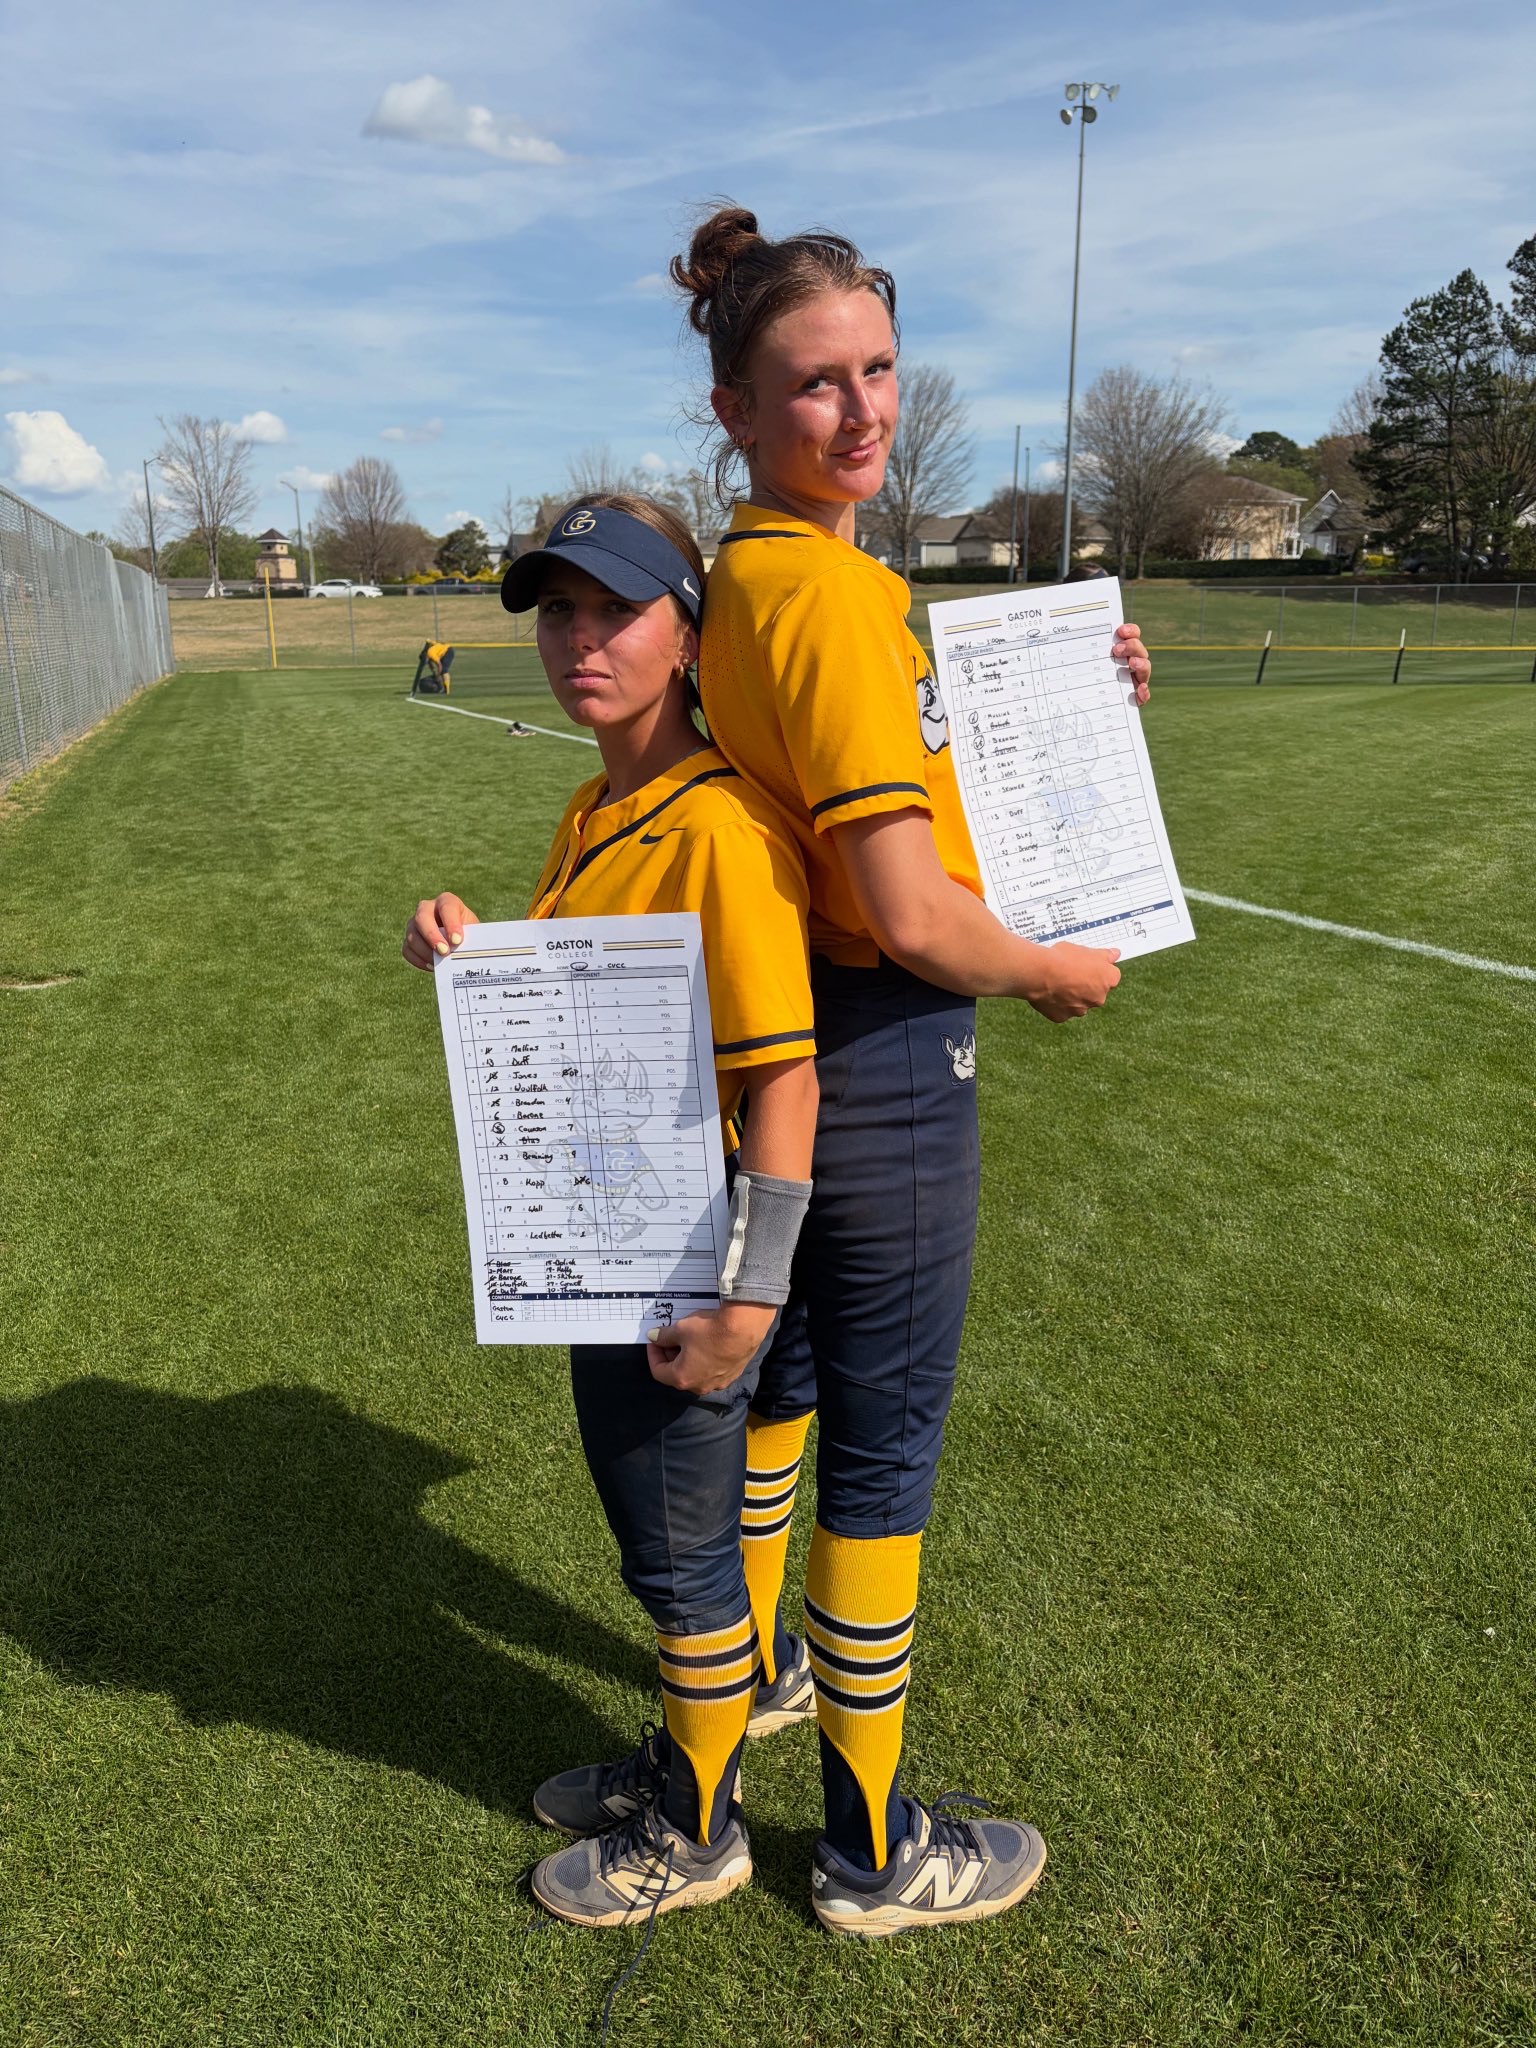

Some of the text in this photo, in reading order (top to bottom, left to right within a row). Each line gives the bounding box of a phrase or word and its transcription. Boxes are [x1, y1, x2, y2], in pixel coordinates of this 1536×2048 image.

[562, 510, 596, 536] G
[1007, 609, 1042, 622] GASTON
[1009, 619, 1043, 629] COLLEGE
[963, 649, 980, 657] COLLEGE
[546, 939, 593, 951] GASTON
[547, 950, 594, 960] COLLEGE
[465, 968, 484, 979] April
[554, 988, 563, 996] 2
[559, 1042, 565, 1050] 3
[565, 1096, 571, 1104] 4
[567, 1123, 574, 1131] 7
[896, 1851, 992, 1909] N
